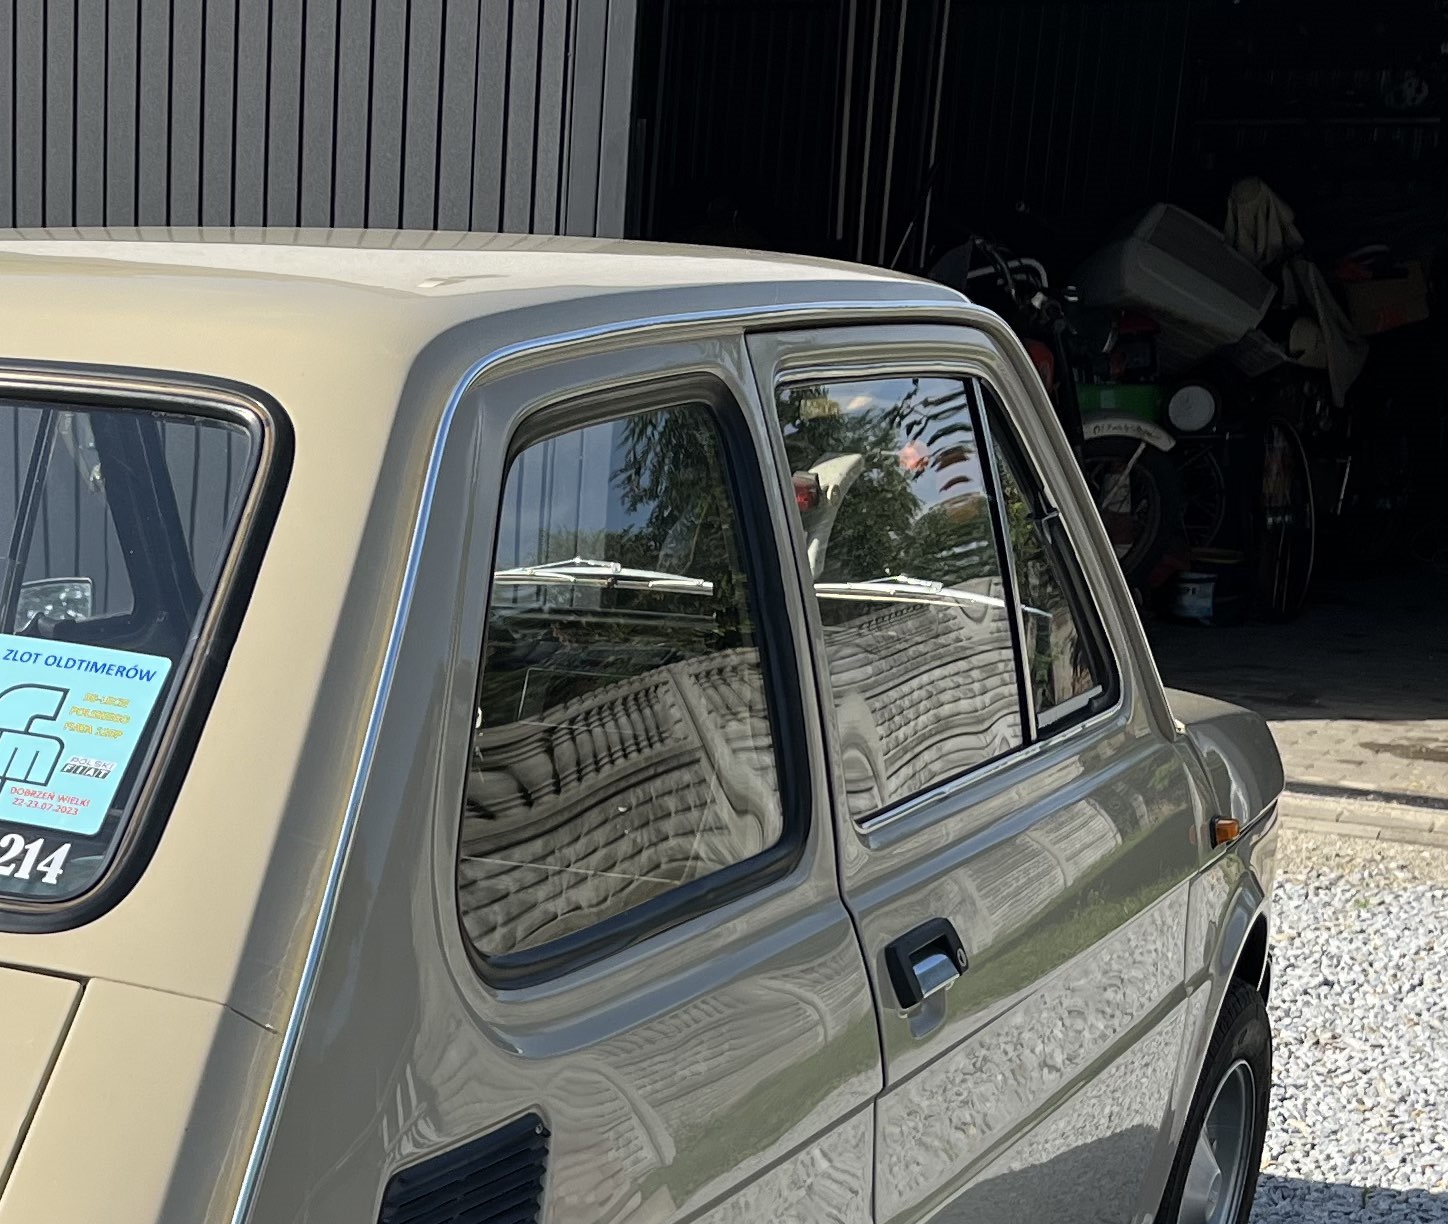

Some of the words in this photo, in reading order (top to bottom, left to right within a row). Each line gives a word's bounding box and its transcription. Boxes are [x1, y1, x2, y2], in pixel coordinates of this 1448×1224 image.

[2, 648, 43, 665] ZLOT
[45, 654, 158, 683] OLDTIMERÓW
[61, 762, 112, 779] FIAT
